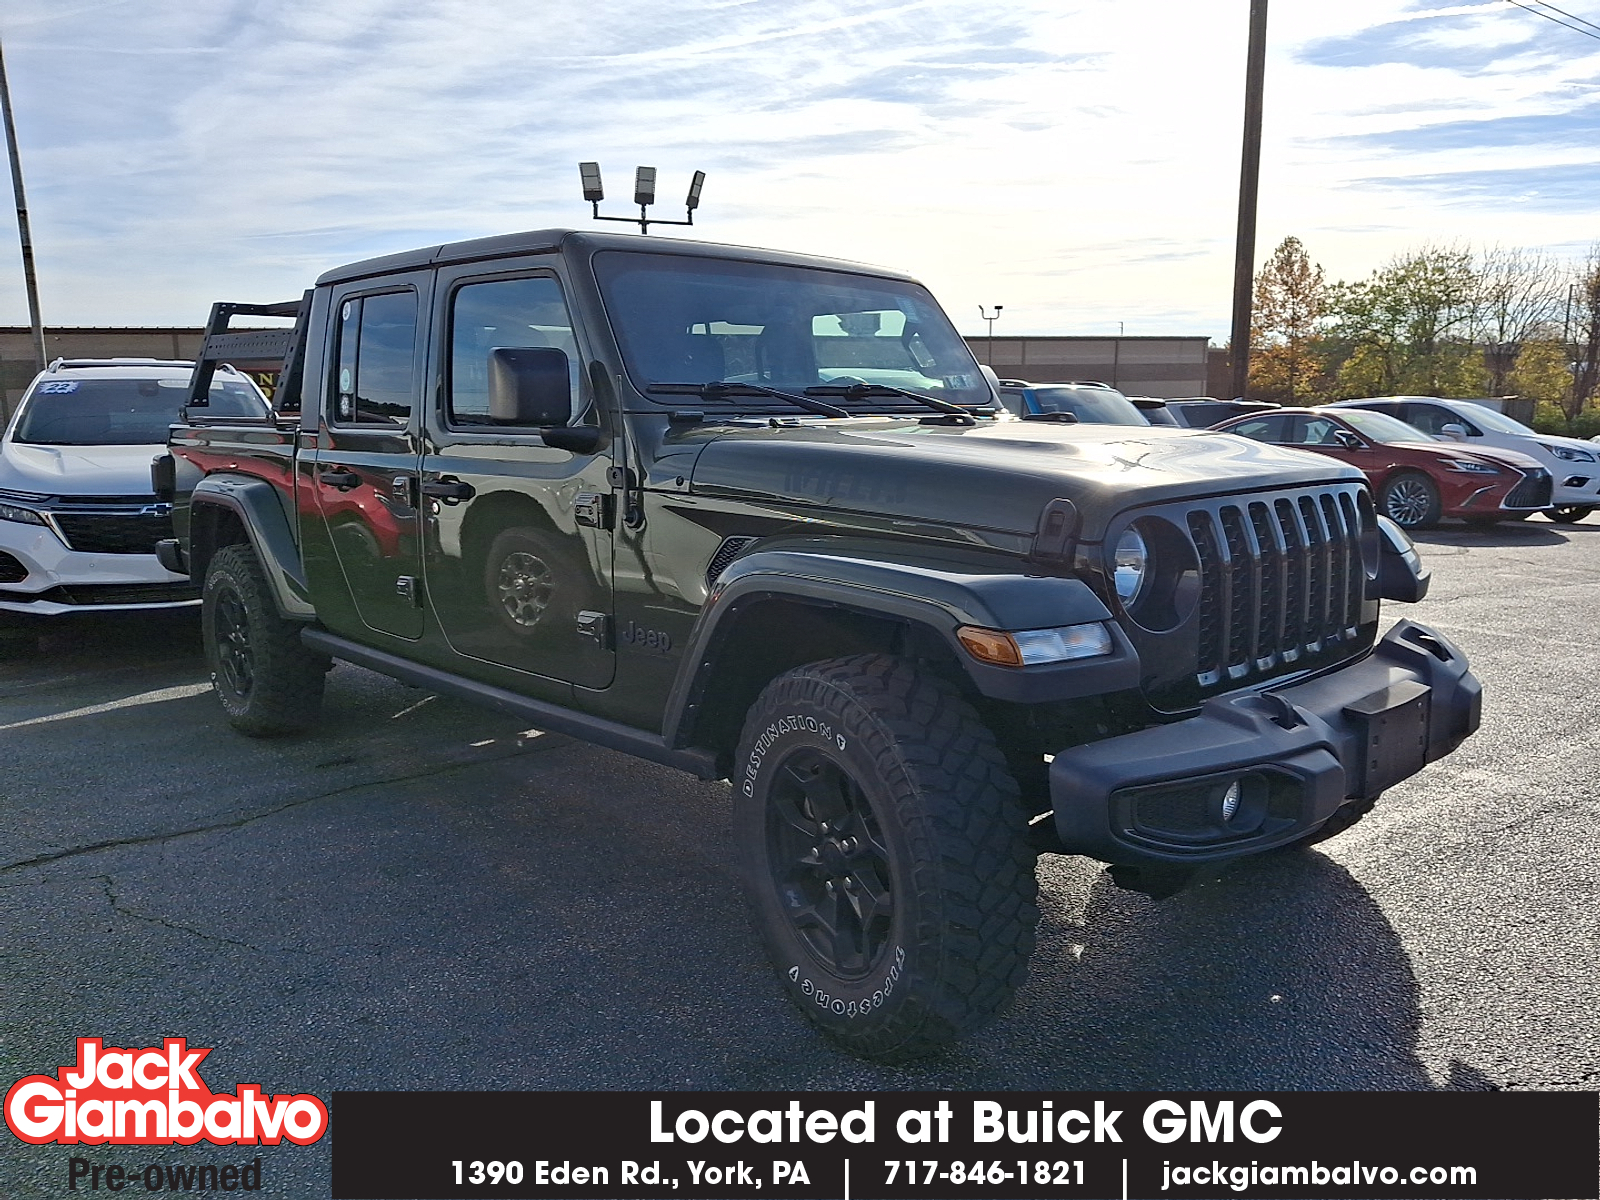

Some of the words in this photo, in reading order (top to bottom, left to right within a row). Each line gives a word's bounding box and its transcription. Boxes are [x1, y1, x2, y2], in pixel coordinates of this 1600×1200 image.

[622, 620, 672, 653] Jeep
[742, 714, 832, 798] DESTINATION
[801, 945, 905, 1019] Firestone
